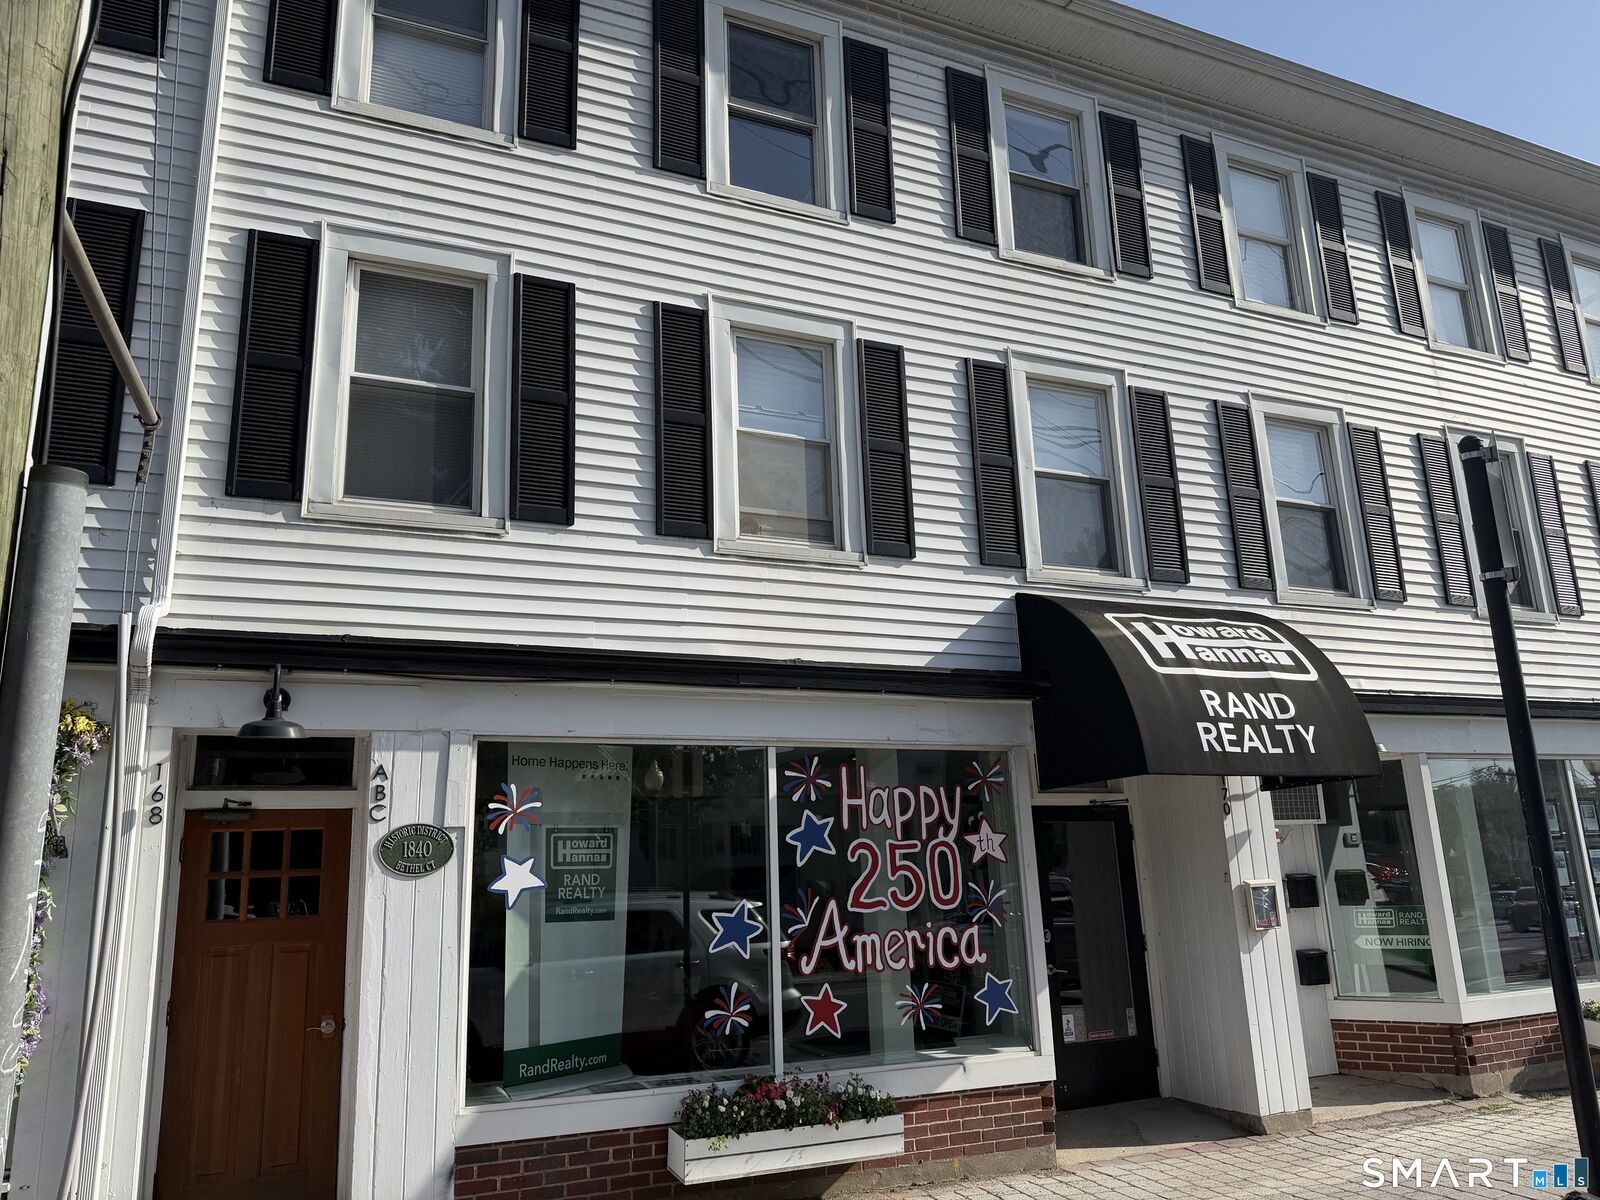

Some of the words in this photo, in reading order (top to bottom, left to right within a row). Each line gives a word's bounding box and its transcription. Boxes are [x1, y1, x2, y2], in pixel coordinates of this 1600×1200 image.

[1130, 621, 1272, 651] Howard
[1132, 631, 1278, 665] Hanna
[1199, 689, 1296, 720] RAND
[1196, 721, 1316, 754] REALTY
[511, 755, 546, 767] Home
[549, 757, 599, 770] Happens
[149, 763, 163, 824] 168
[839, 763, 962, 841] Happy
[384, 825, 417, 849] HISTORIC
[417, 825, 449, 844] DISTRICT
[557, 837, 608, 855] Howard
[402, 840, 433, 858] 1840
[557, 844, 601, 863] Hanna
[395, 860, 425, 873] BETHEL
[425, 860, 436, 871] CT
[847, 838, 963, 913] 250
[976, 832, 995, 852] th
[563, 873, 601, 887] RAND
[558, 886, 606, 900] REALTY
[555, 906, 607, 917] RandRealty.com
[1357, 911, 1391, 921] Howard
[1398, 911, 1423, 919] RAND
[1399, 918, 1428, 926] REALT
[800, 897, 988, 975] America
[1365, 937, 1393, 947] NOW
[519, 1053, 607, 1079] RandRealty.com
